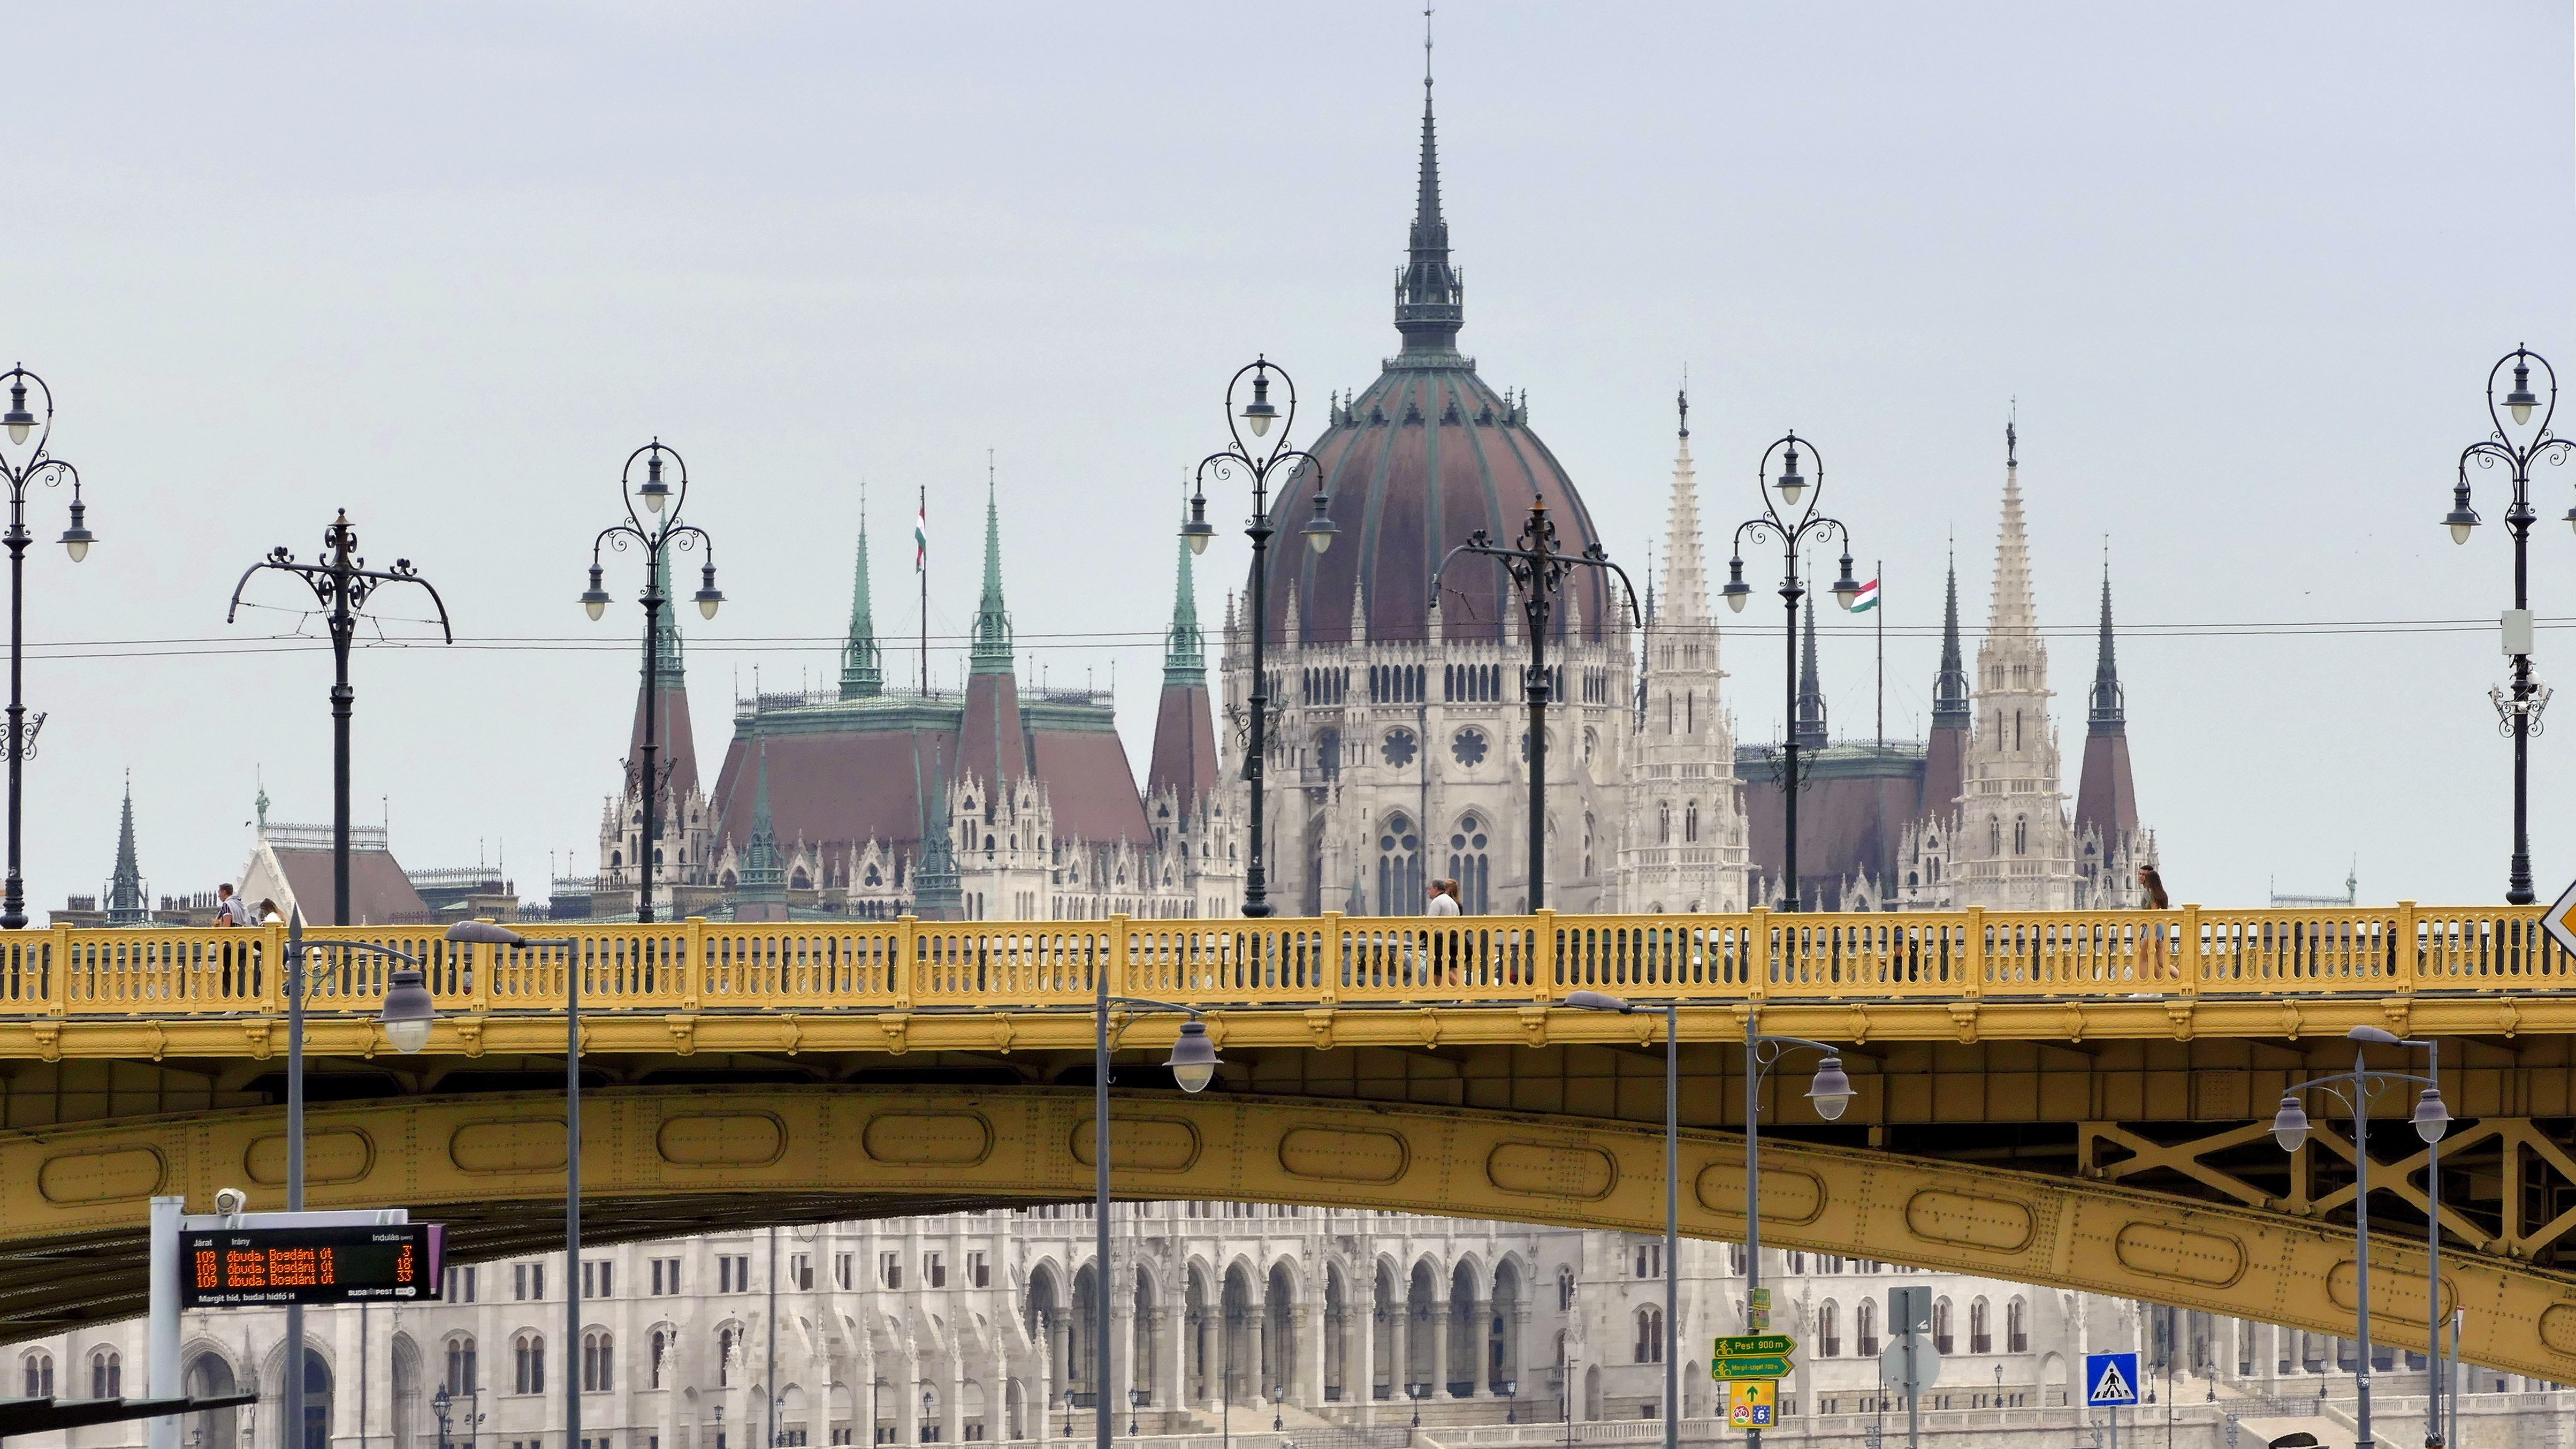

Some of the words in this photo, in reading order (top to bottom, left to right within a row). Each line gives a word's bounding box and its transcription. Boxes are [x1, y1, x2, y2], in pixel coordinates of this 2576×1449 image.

[193, 1239, 213, 1247] Járat
[232, 1238, 250, 1246] Irány
[196, 1251, 215, 1263] 109
[320, 1248, 333, 1259] út
[197, 1263, 216, 1275] 109
[321, 1260, 333, 1271] út
[197, 1276, 217, 1287] 109
[321, 1272, 334, 1284] út
[199, 1294, 225, 1303] Margit
[1735, 1341, 1754, 1349] Pest
[1758, 1341, 1774, 1349] 900
[1757, 1409, 1765, 1420] 6
